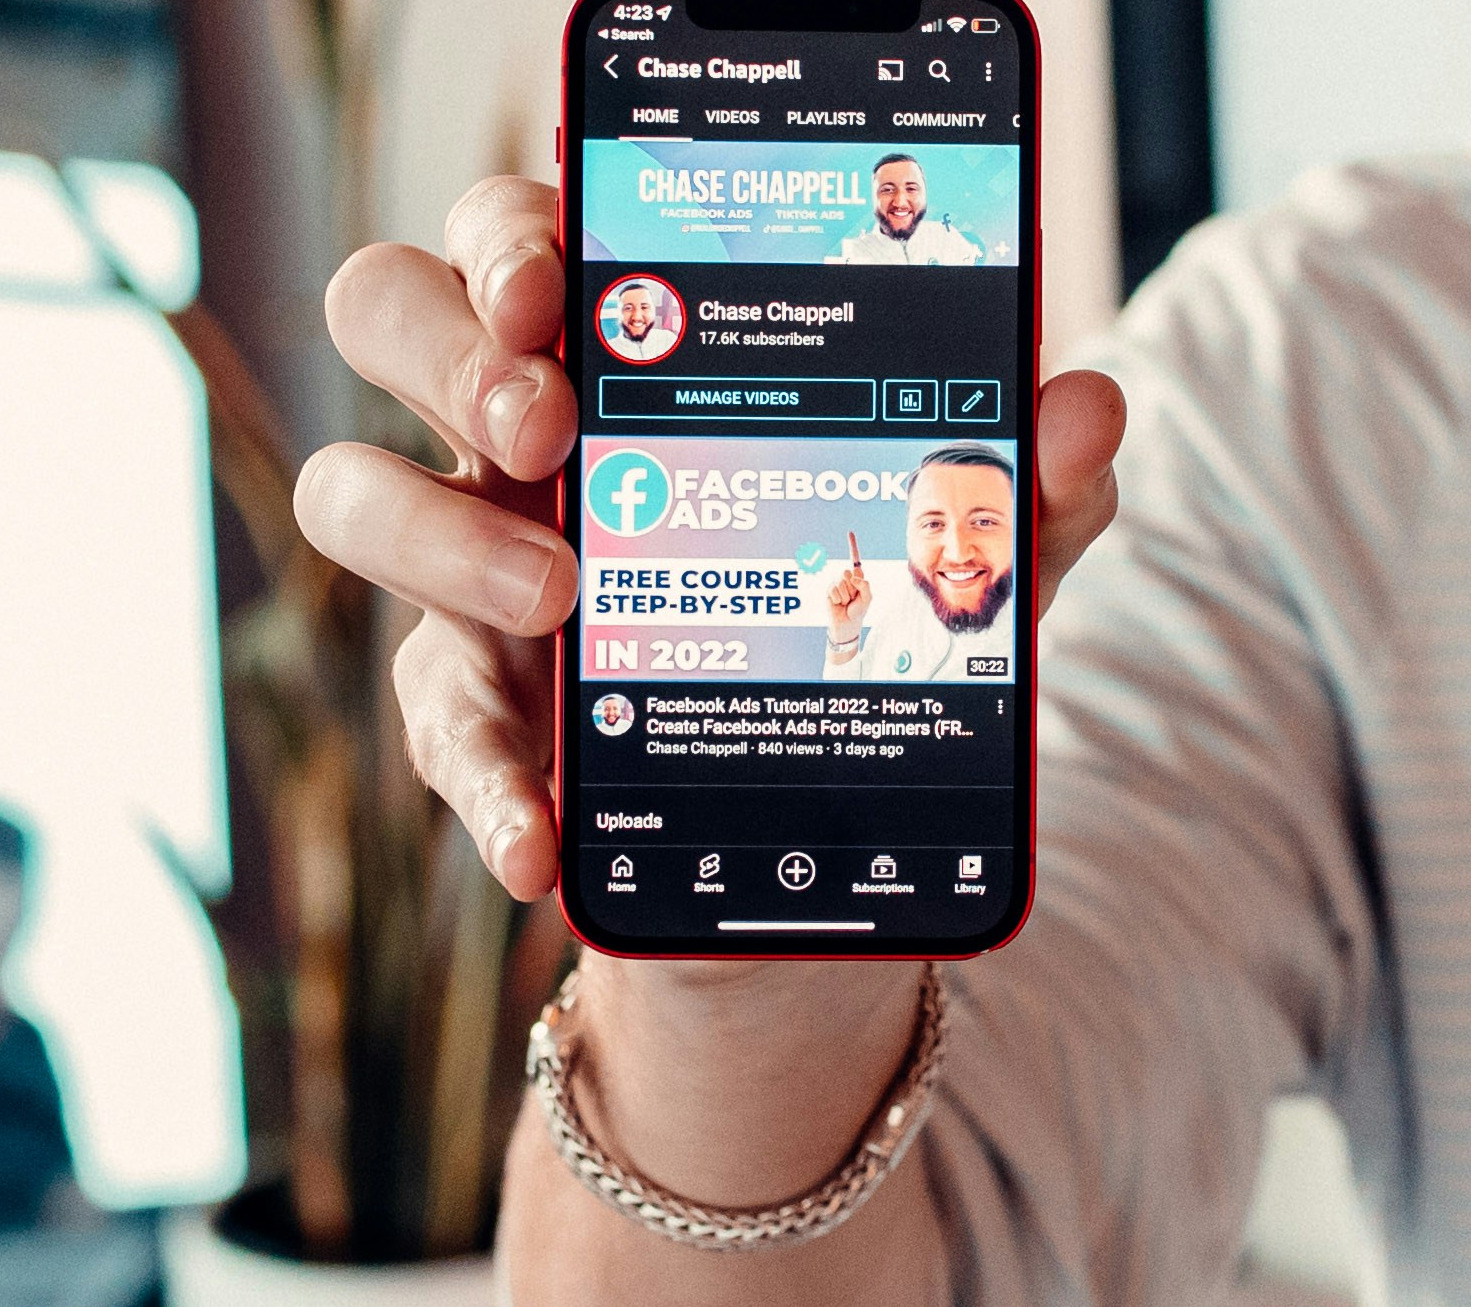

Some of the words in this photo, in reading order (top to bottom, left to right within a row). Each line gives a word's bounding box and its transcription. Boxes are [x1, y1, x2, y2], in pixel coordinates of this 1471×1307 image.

[613, 4, 654, 21] 4:23
[611, 29, 654, 41] Search
[637, 57, 702, 79] Chase
[707, 57, 802, 84] Chappell
[633, 109, 679, 124] HOME
[705, 110, 761, 125] VIDEOS
[787, 111, 866, 126] PLAYLISTS
[892, 112, 987, 127] COMMUNITY
[638, 168, 726, 204] CHASE
[732, 169, 867, 206] CHAPPELL
[660, 208, 726, 220] FACEBOOK
[728, 208, 753, 220] ADS
[775, 209, 818, 221] TIKTOK
[820, 210, 845, 221] ADS
[698, 300, 762, 322] Chase
[766, 301, 854, 327] Chappell
[699, 331, 740, 345] 17.6K
[742, 332, 825, 346] subscribers
[675, 390, 742, 405] MANAGE
[744, 391, 799, 406] VIDEOS
[674, 469, 909, 502] FACEBOOK
[667, 499, 758, 531] ADS
[599, 569, 671, 589] FREE
[681, 570, 799, 590] COURSE
[595, 594, 802, 615] STEP-BY-STEP
[594, 639, 638, 670] IN
[649, 639, 749, 671] 2022
[970, 660, 1005, 673] 30:22
[646, 697, 725, 713] Facebook
[728, 698, 761, 714] Ads
[763, 698, 824, 714] Tutorial
[828, 699, 869, 714] 2022
[882, 699, 918, 714] How
[921, 699, 943, 715] To
[646, 718, 700, 735] Create
[703, 718, 782, 735] Facebook
[784, 719, 817, 735] Ads
[820, 720, 847, 735] For
[851, 720, 930, 739] Beginners
[646, 741, 688, 754] Chase
[690, 742, 748, 757] Chappell
[757, 743, 783, 755] 840
[785, 743, 823, 755] views
[833, 744, 842, 755] 3
[845, 743, 876, 758] days
[879, 746, 904, 758] ago
[596, 812, 663, 832] Uploads
[607, 882, 636, 892] Home
[694, 882, 725, 892] Shorts
[852, 883, 915, 894] Subscriptions
[954, 883, 986, 895] Library
